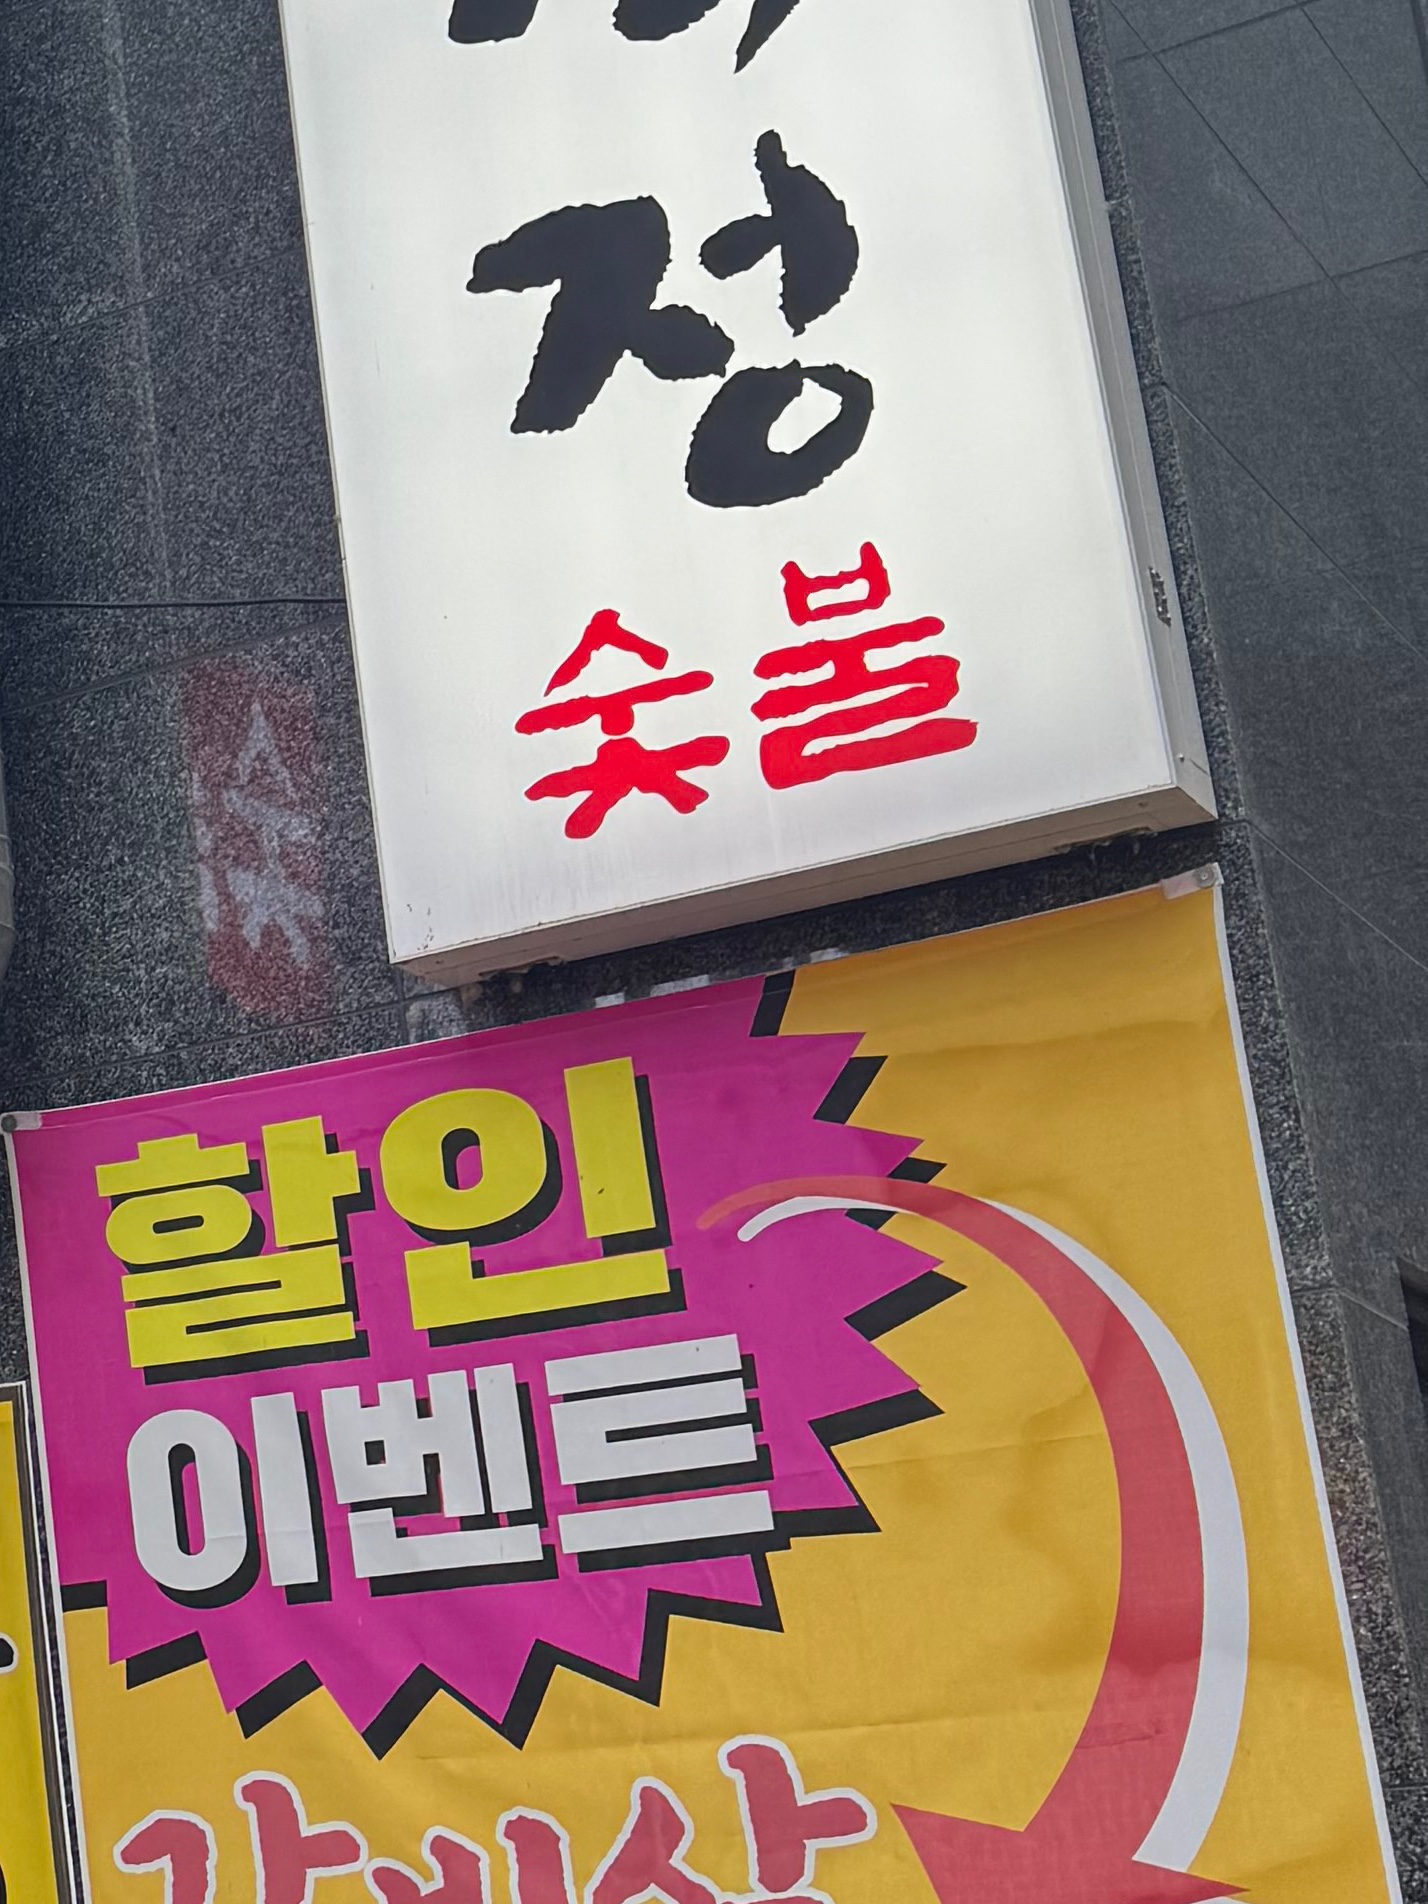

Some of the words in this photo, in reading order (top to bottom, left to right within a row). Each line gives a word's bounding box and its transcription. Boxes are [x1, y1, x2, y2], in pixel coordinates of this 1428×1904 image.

[515, 540, 977, 840] 숯불
[95, 1057, 672, 1369] 할인
[125, 1334, 778, 1596] 이벤트
